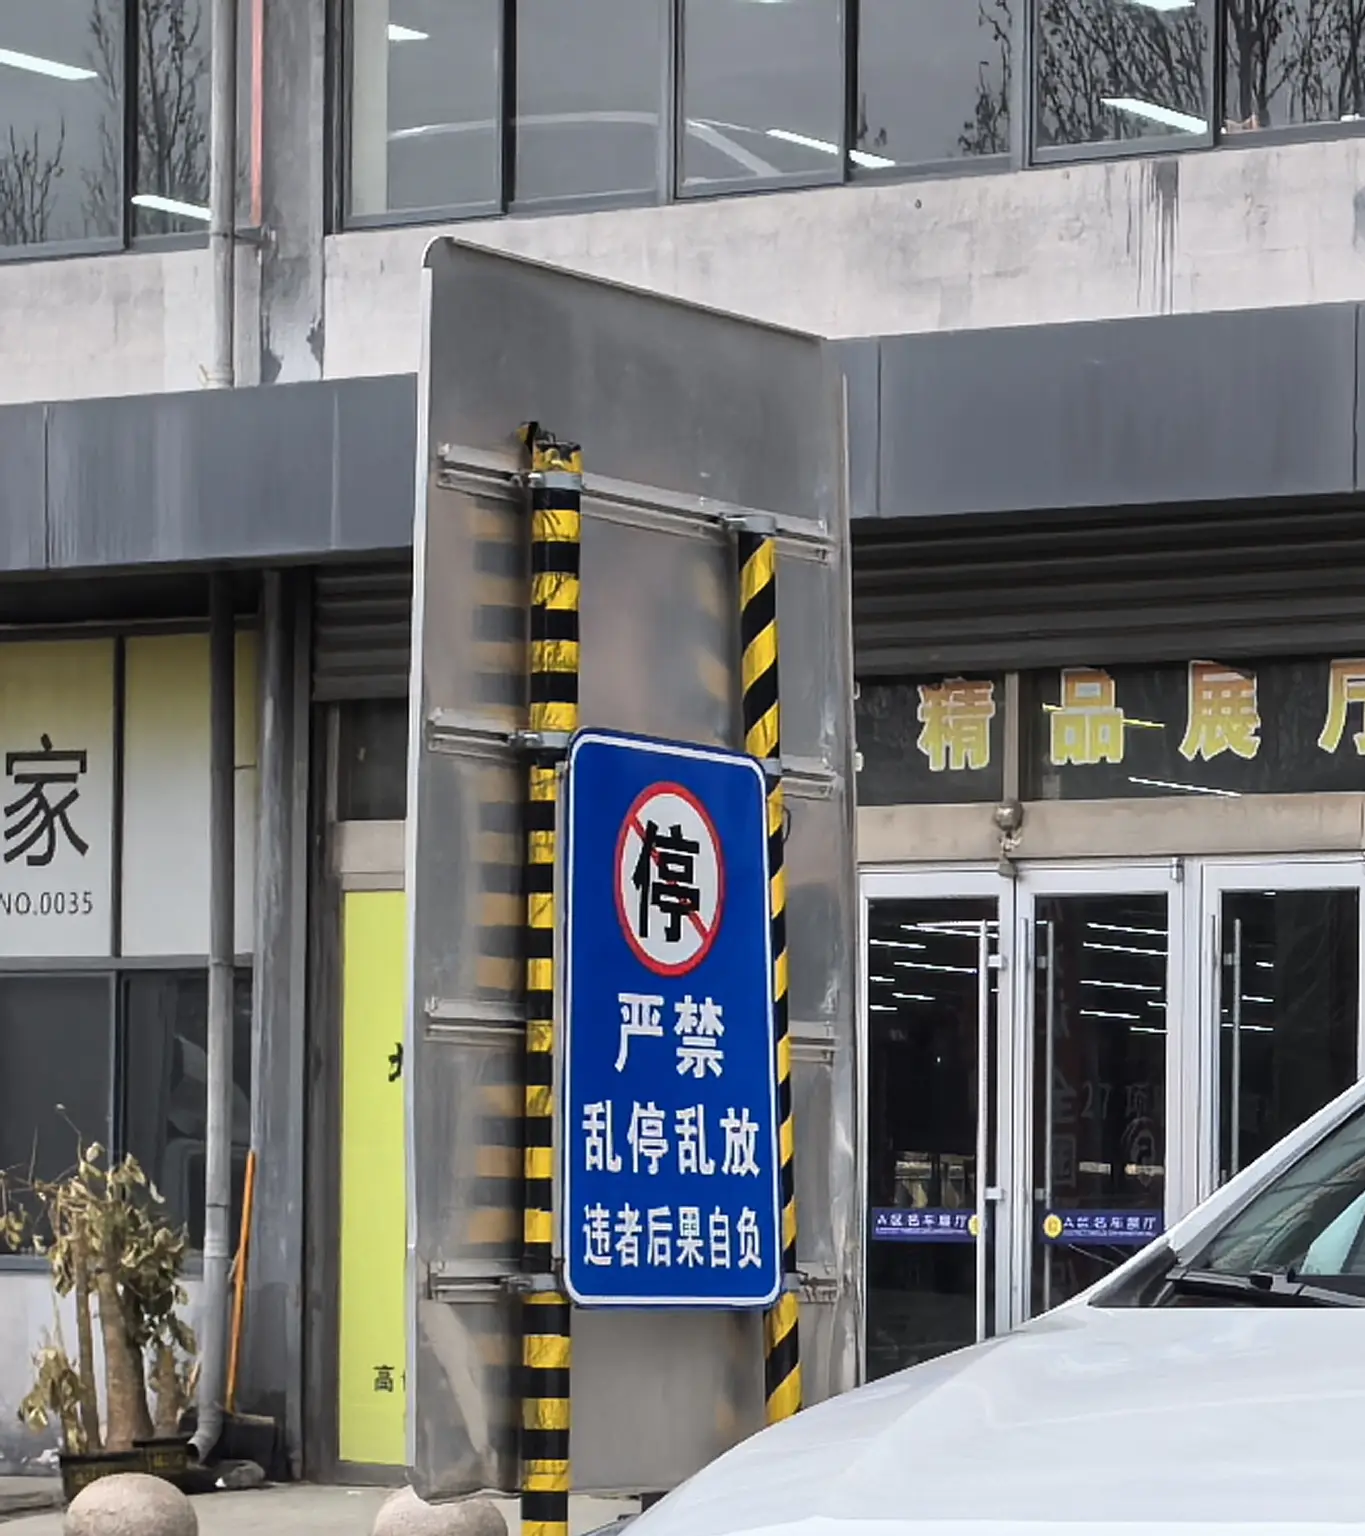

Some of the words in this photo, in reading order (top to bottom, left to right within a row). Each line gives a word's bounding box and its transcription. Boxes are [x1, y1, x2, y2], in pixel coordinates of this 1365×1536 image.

[3, 732, 90, 867] 家
[0, 891, 94, 916] NO.0035
[632, 820, 700, 942] 停
[614, 992, 725, 1079] 严禁
[582, 1099, 761, 1178] 乱停乱放
[582, 1202, 762, 1270] 违者后果自负
